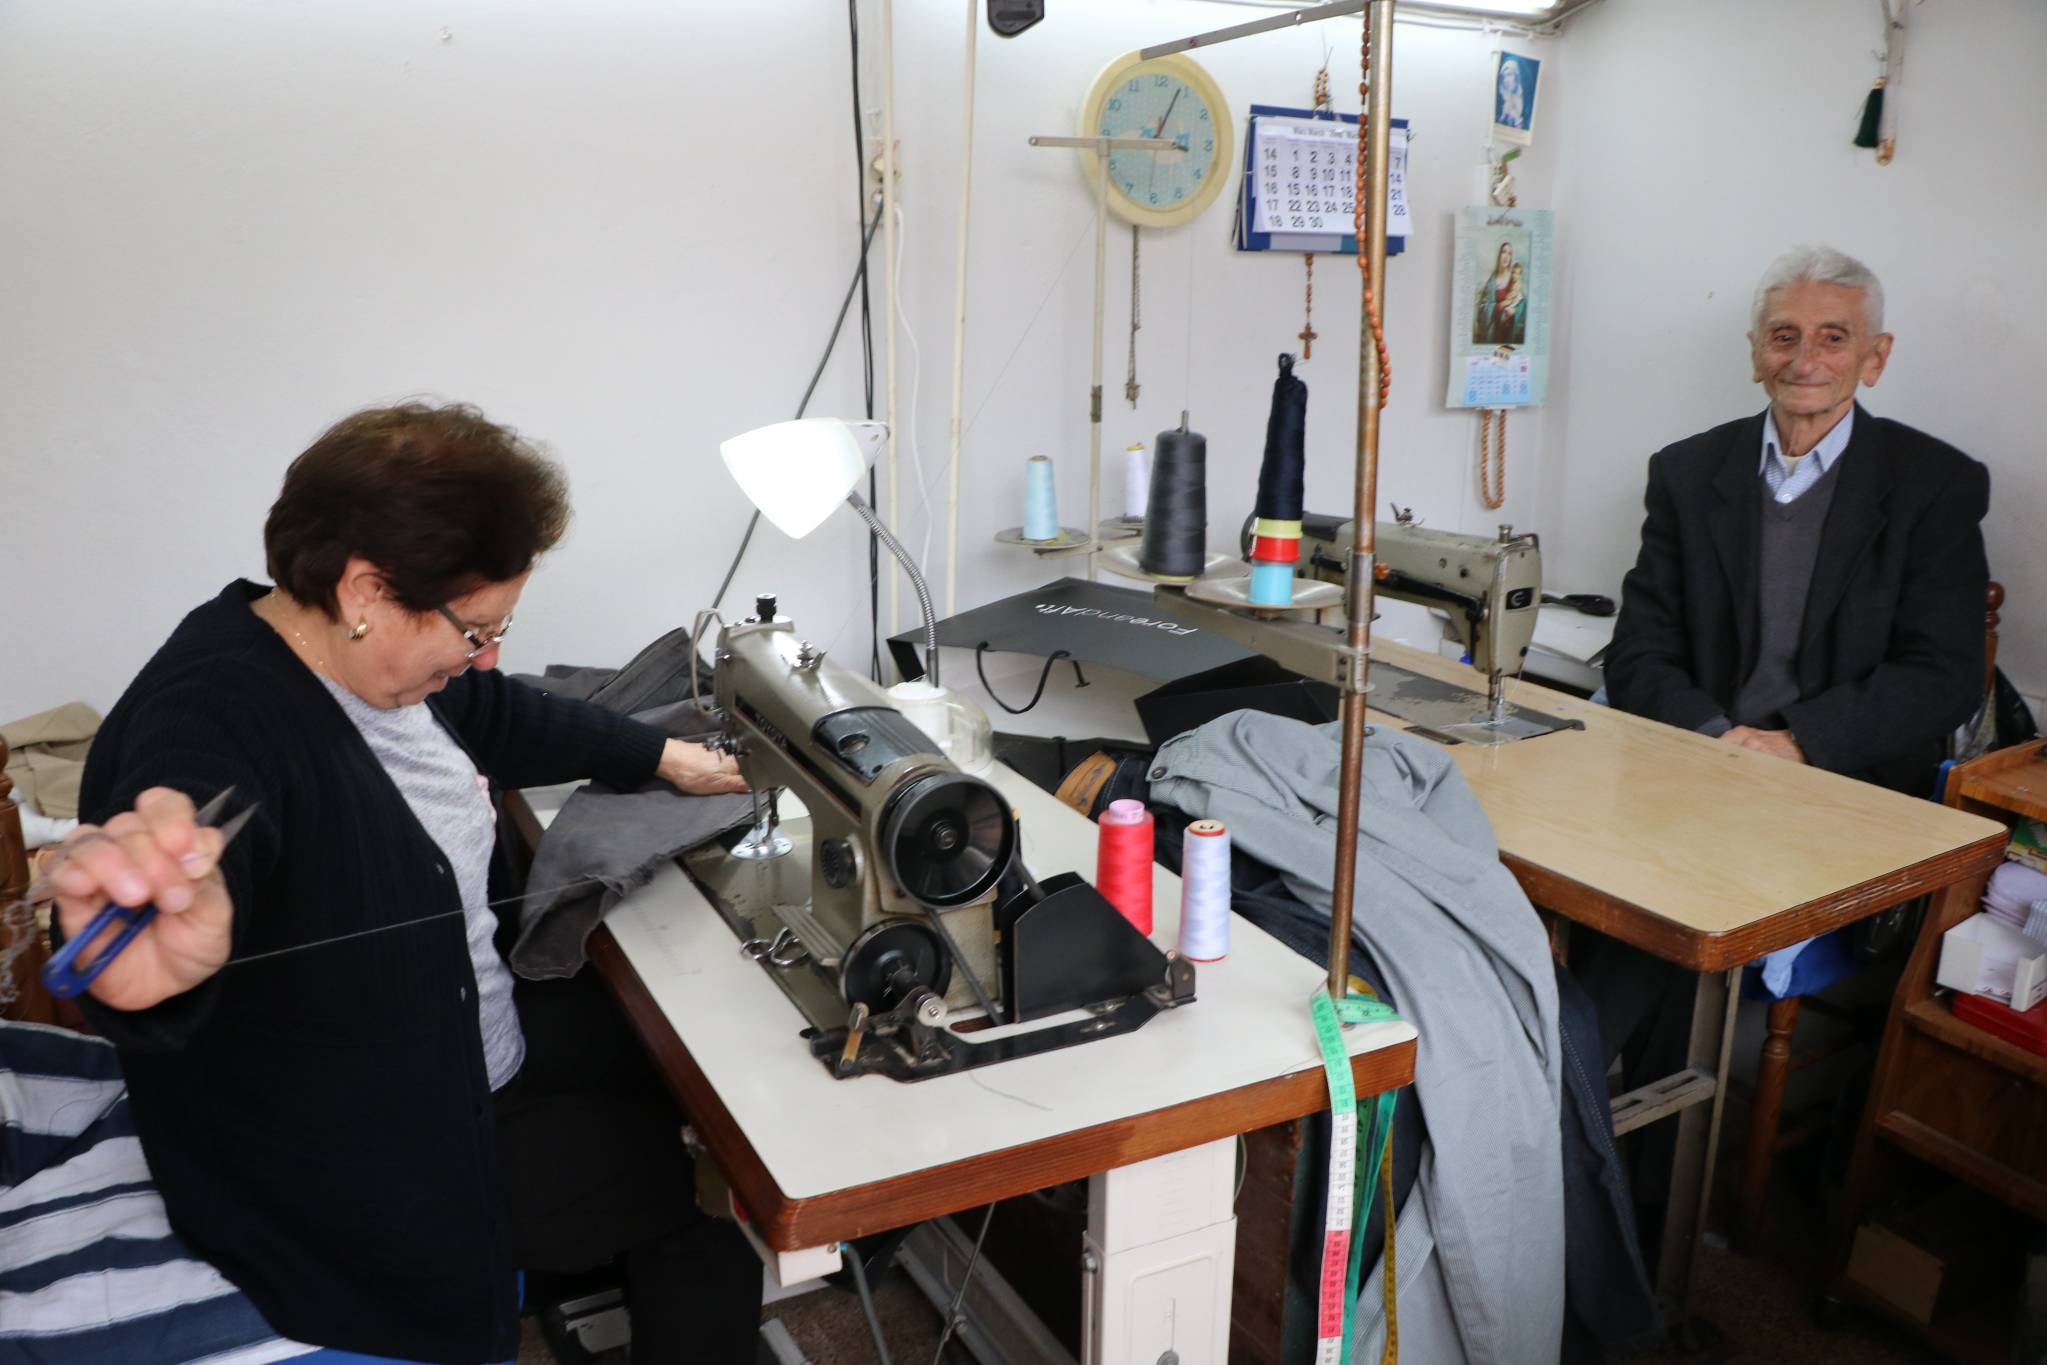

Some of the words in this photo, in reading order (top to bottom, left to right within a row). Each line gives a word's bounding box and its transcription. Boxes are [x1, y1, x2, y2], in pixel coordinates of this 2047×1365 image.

[1128, 79, 1140, 92] 11
[1154, 75, 1169, 88] 12
[1183, 86, 1189, 98] 1
[1108, 98, 1121, 111] 10
[1199, 108, 1208, 120] 2
[1203, 140, 1213, 151] 3
[1264, 148, 1277, 160] 14
[1293, 150, 1299, 162] 1
[1310, 150, 1318, 163] 2
[1328, 152, 1336, 165] 3
[1344, 153, 1352, 166] 4
[1395, 156, 1402, 169] 7
[1193, 168, 1202, 180] 4
[1264, 165, 1277, 177] 15
[1310, 167, 1317, 180] 9
[1322, 168, 1335, 181] 10
[1340, 169, 1351, 182] 11
[1125, 182, 1134, 194] 7
[1265, 182, 1278, 194] 16
[1287, 183, 1300, 196] 15
[1305, 184, 1318, 197] 16
[1323, 185, 1335, 197] 17
[1341, 186, 1353, 198] 18
[1390, 189, 1402, 200] 21
[1266, 199, 1279, 211] 17
[1288, 199, 1303, 212] 22
[1306, 200, 1320, 213] 23
[1324, 201, 1338, 214] 24
[1269, 215, 1283, 227] 18
[1291, 216, 1305, 228] 29
[1309, 216, 1324, 228] 30
